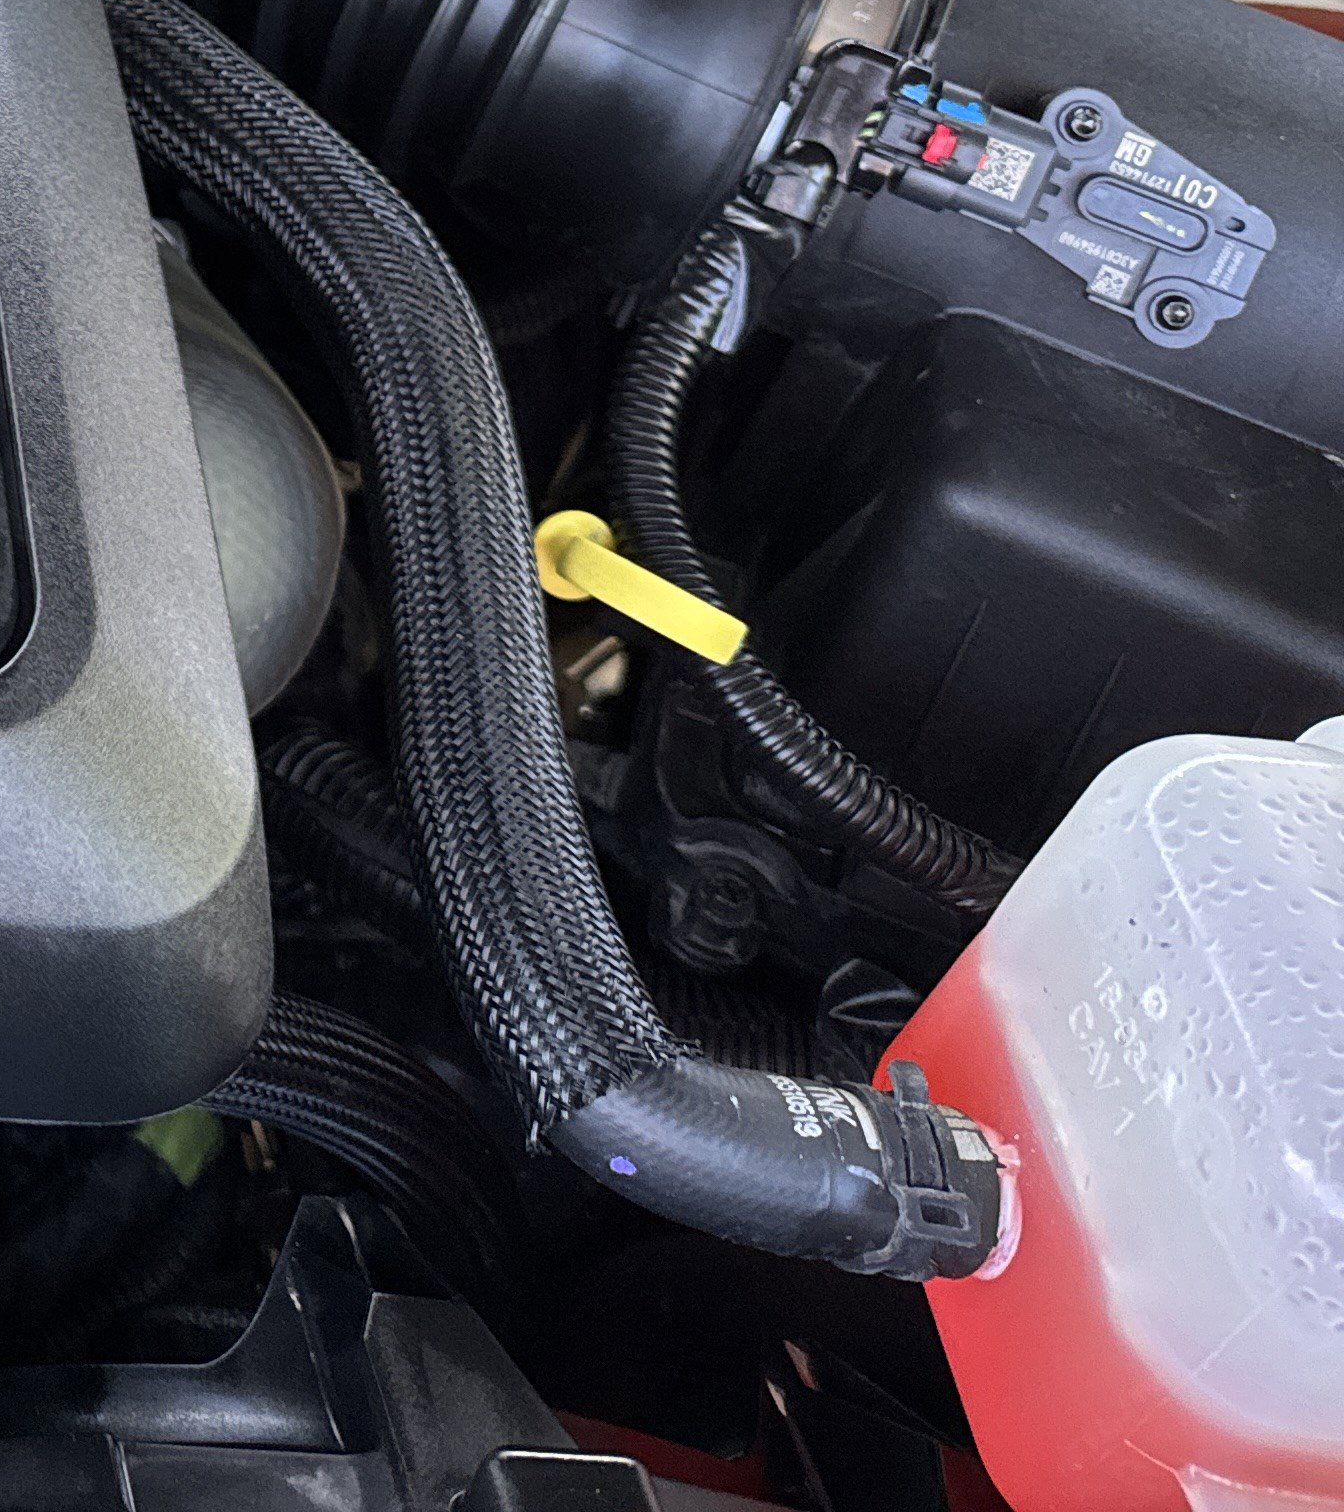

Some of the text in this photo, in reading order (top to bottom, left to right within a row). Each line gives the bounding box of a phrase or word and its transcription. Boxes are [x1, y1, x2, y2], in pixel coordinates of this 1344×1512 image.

[1114, 136, 1155, 167] GM
[1172, 174, 1218, 209] C01
[803, 1085, 858, 1128] TNK
